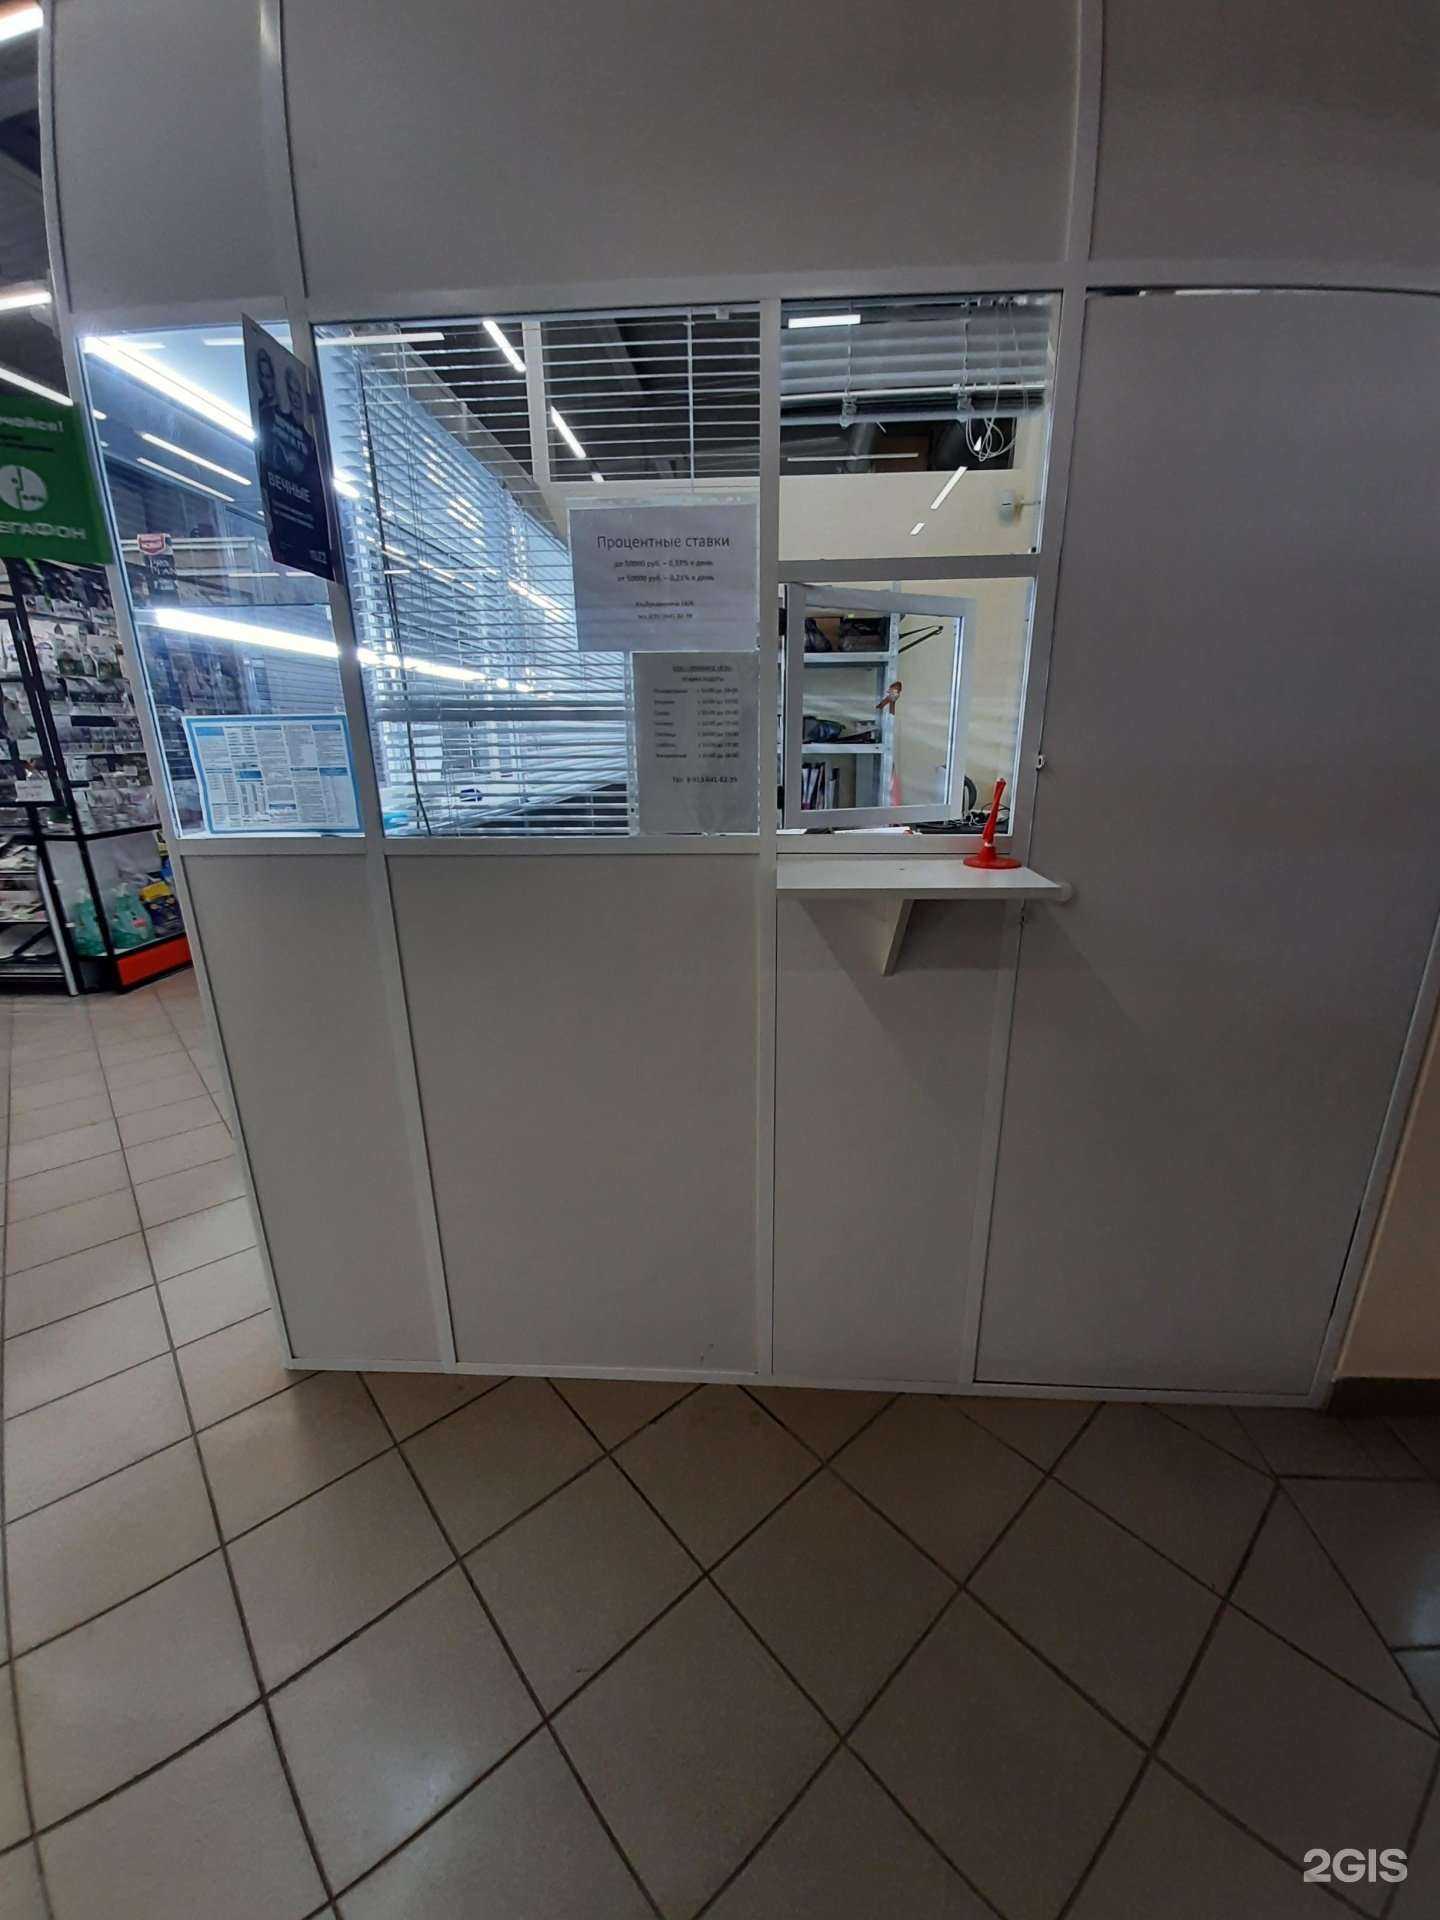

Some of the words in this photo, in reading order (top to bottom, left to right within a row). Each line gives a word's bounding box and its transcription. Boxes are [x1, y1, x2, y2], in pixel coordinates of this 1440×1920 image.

[267, 471, 312, 503] ВЕЧНЫЕ
[0, 520, 87, 540] ЕГАФОН
[597, 536, 681, 551] Процентные
[685, 536, 730, 548] ставки
